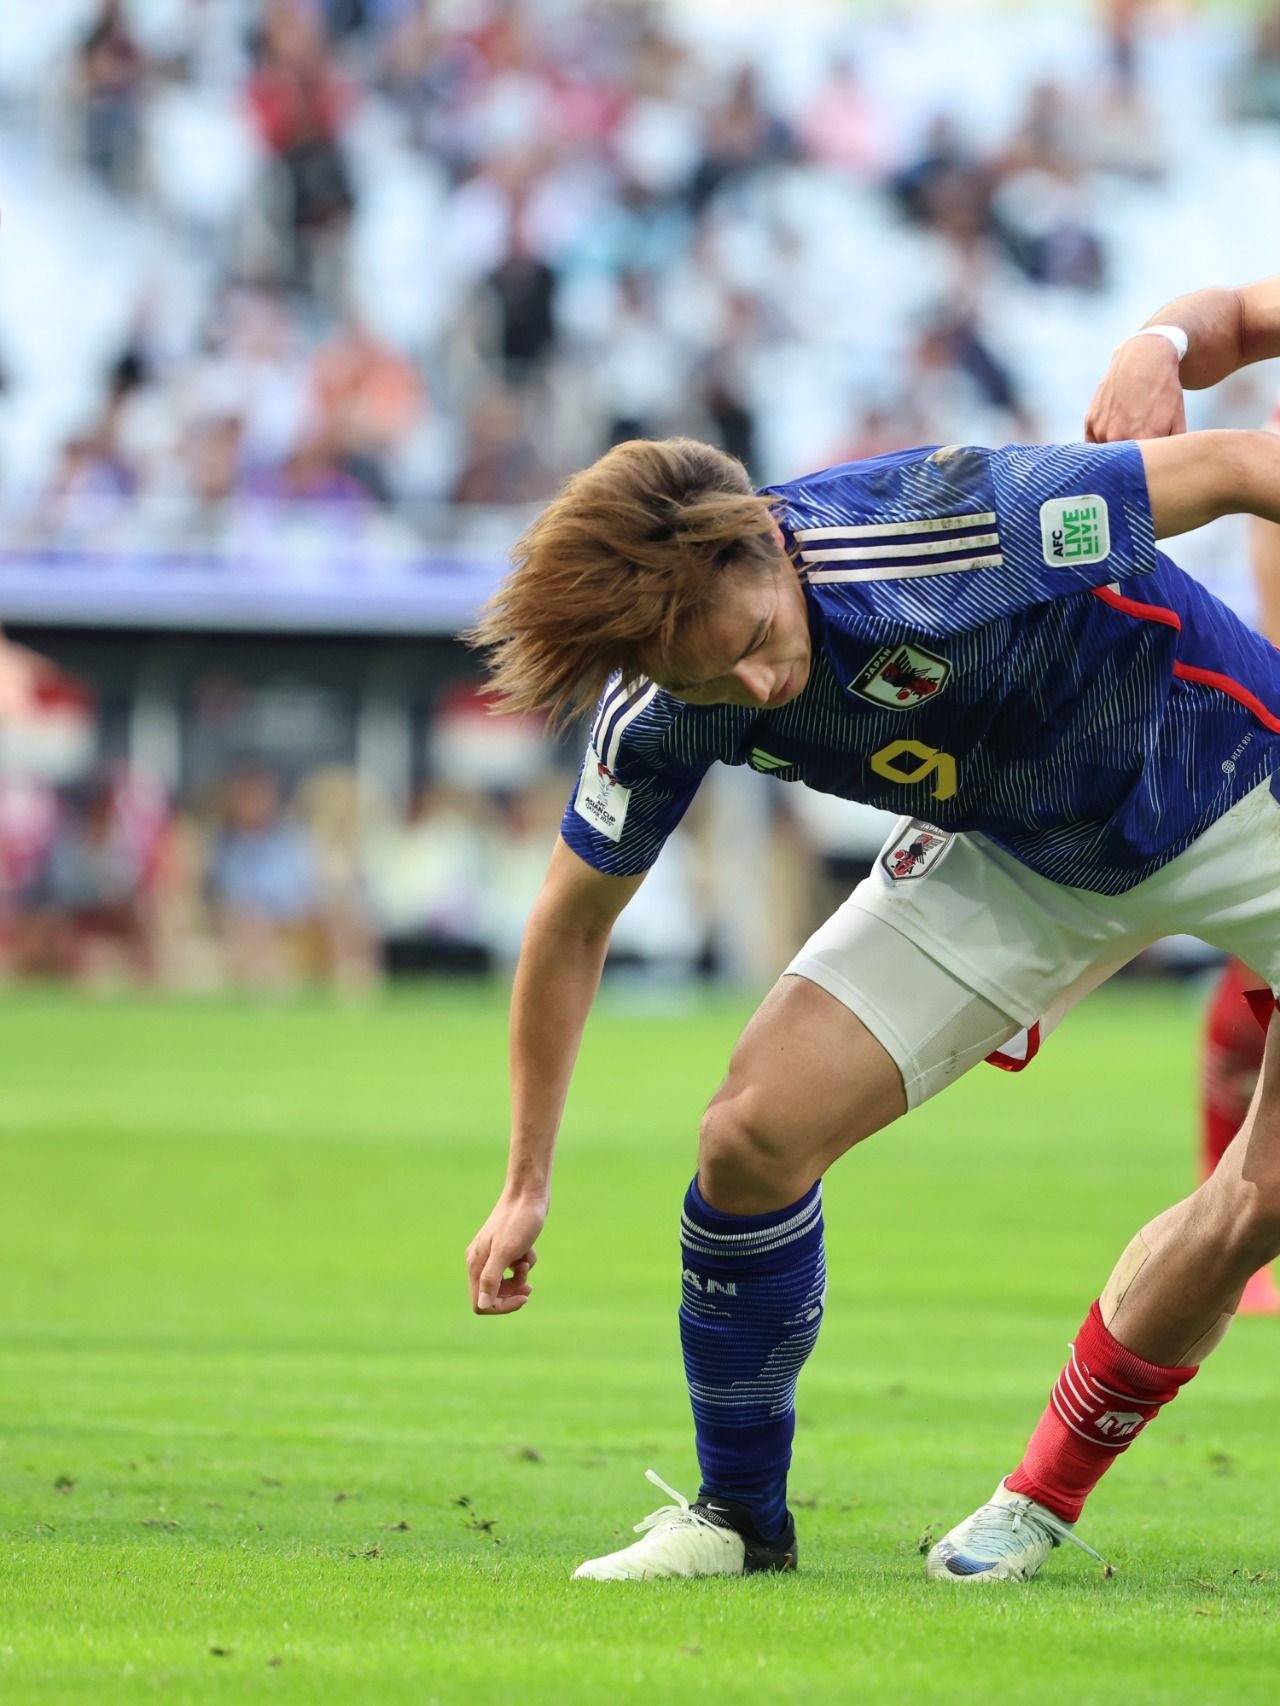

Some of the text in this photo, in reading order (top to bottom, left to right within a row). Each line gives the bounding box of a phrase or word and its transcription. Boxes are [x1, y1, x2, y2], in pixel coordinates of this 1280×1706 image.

[1052, 530, 1064, 558] AFC
[1062, 508, 1082, 557] LIVE
[864, 648, 892, 680] JAPAN
[870, 739, 958, 801] 9
[585, 797, 616, 822] ASIAN CUP
